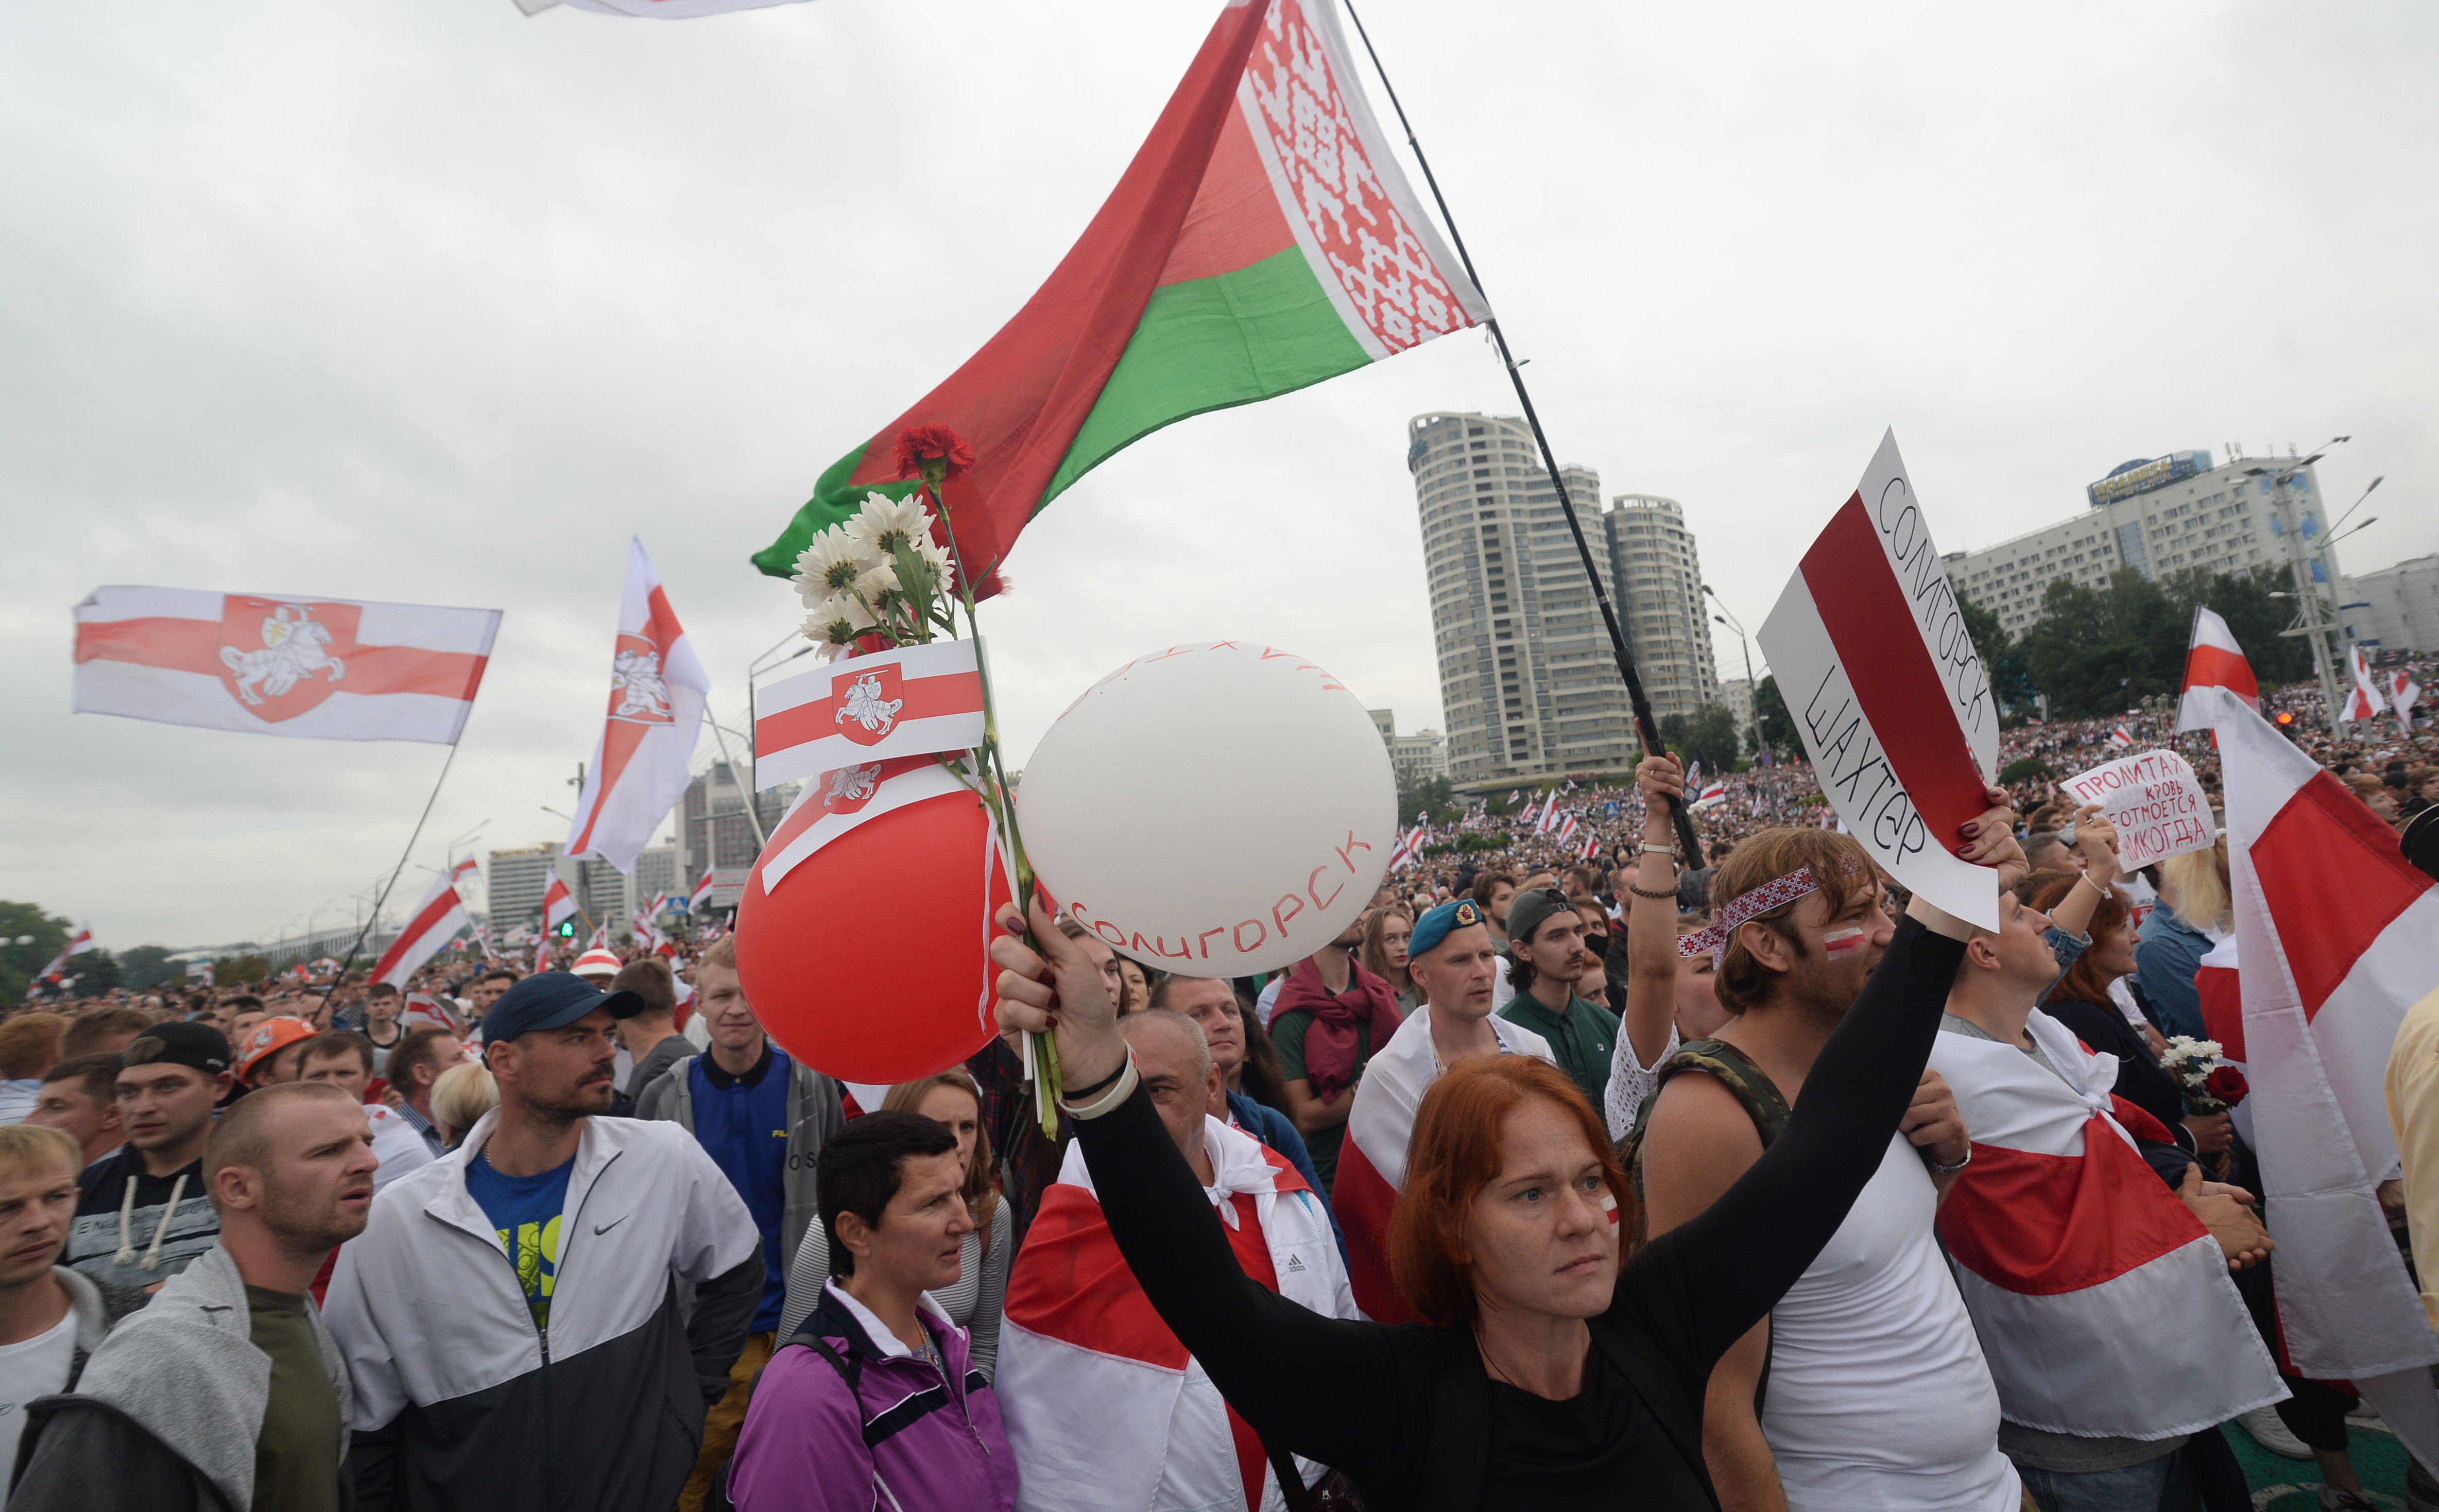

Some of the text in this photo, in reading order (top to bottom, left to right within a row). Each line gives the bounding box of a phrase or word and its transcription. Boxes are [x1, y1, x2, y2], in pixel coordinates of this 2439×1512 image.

[2094, 460, 2172, 496] ПЛАНЕТА
[1879, 477, 1987, 734] СОЛИГОРСК
[2075, 753, 2184, 800] ПРОЛИТАЯ
[2145, 779, 2184, 801] КРОВЬ
[2106, 794, 2197, 827] Е ОТМОЕТСЯ
[1071, 829, 1371, 960] СОЛИГОРСК
